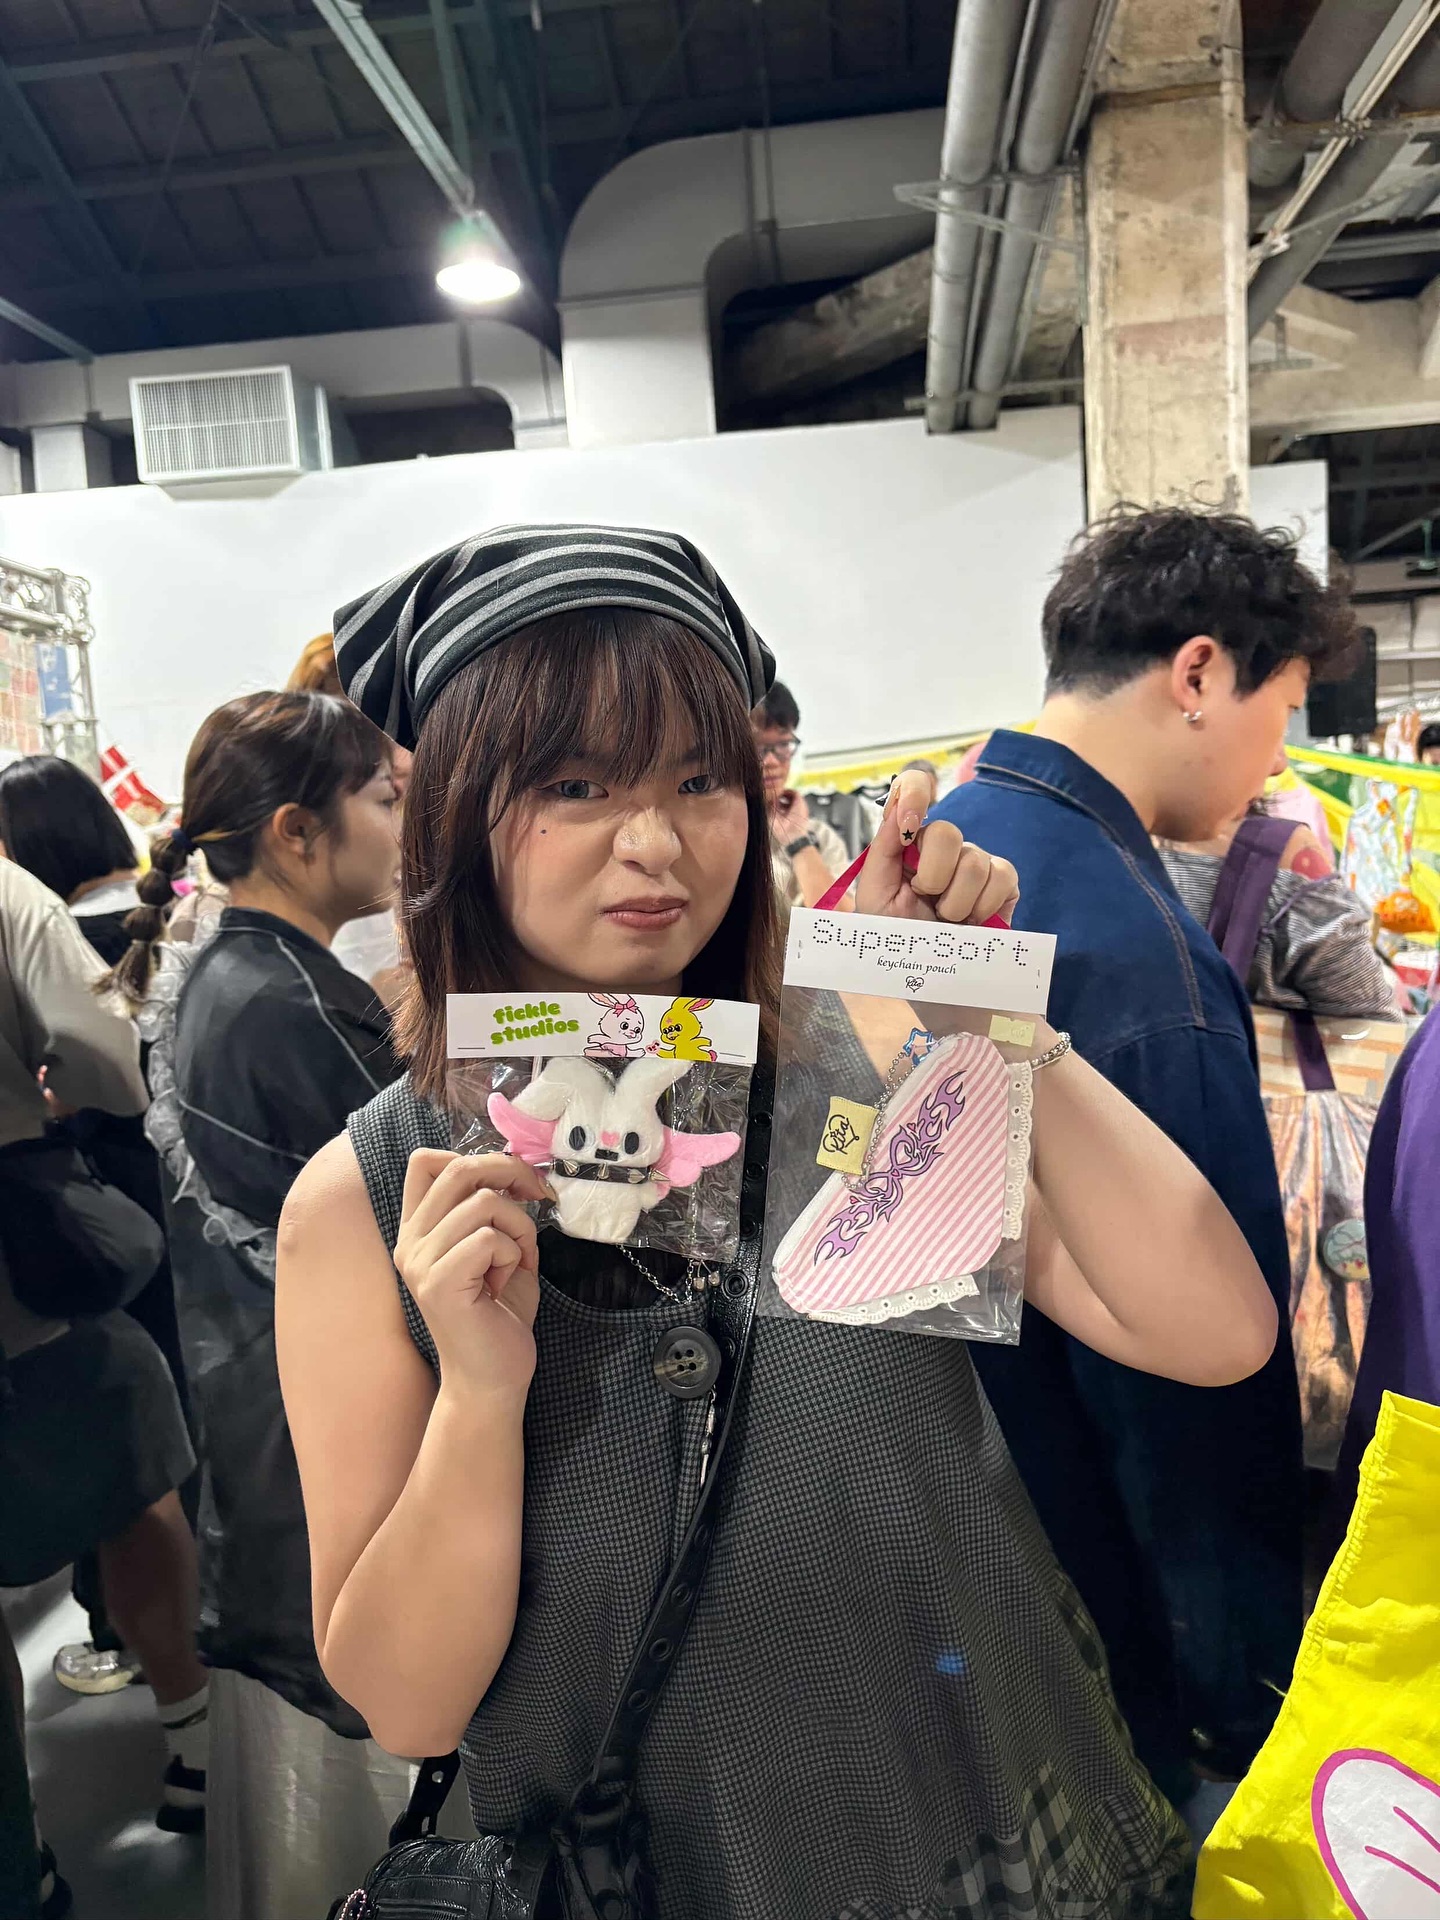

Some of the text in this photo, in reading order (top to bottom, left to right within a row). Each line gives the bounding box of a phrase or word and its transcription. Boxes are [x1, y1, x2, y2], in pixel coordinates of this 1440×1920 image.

[813, 918, 1029, 966] SuperSoft
[877, 956, 957, 975] keychain pouch
[493, 1001, 561, 1024] fickle
[490, 1018, 579, 1045] studios
